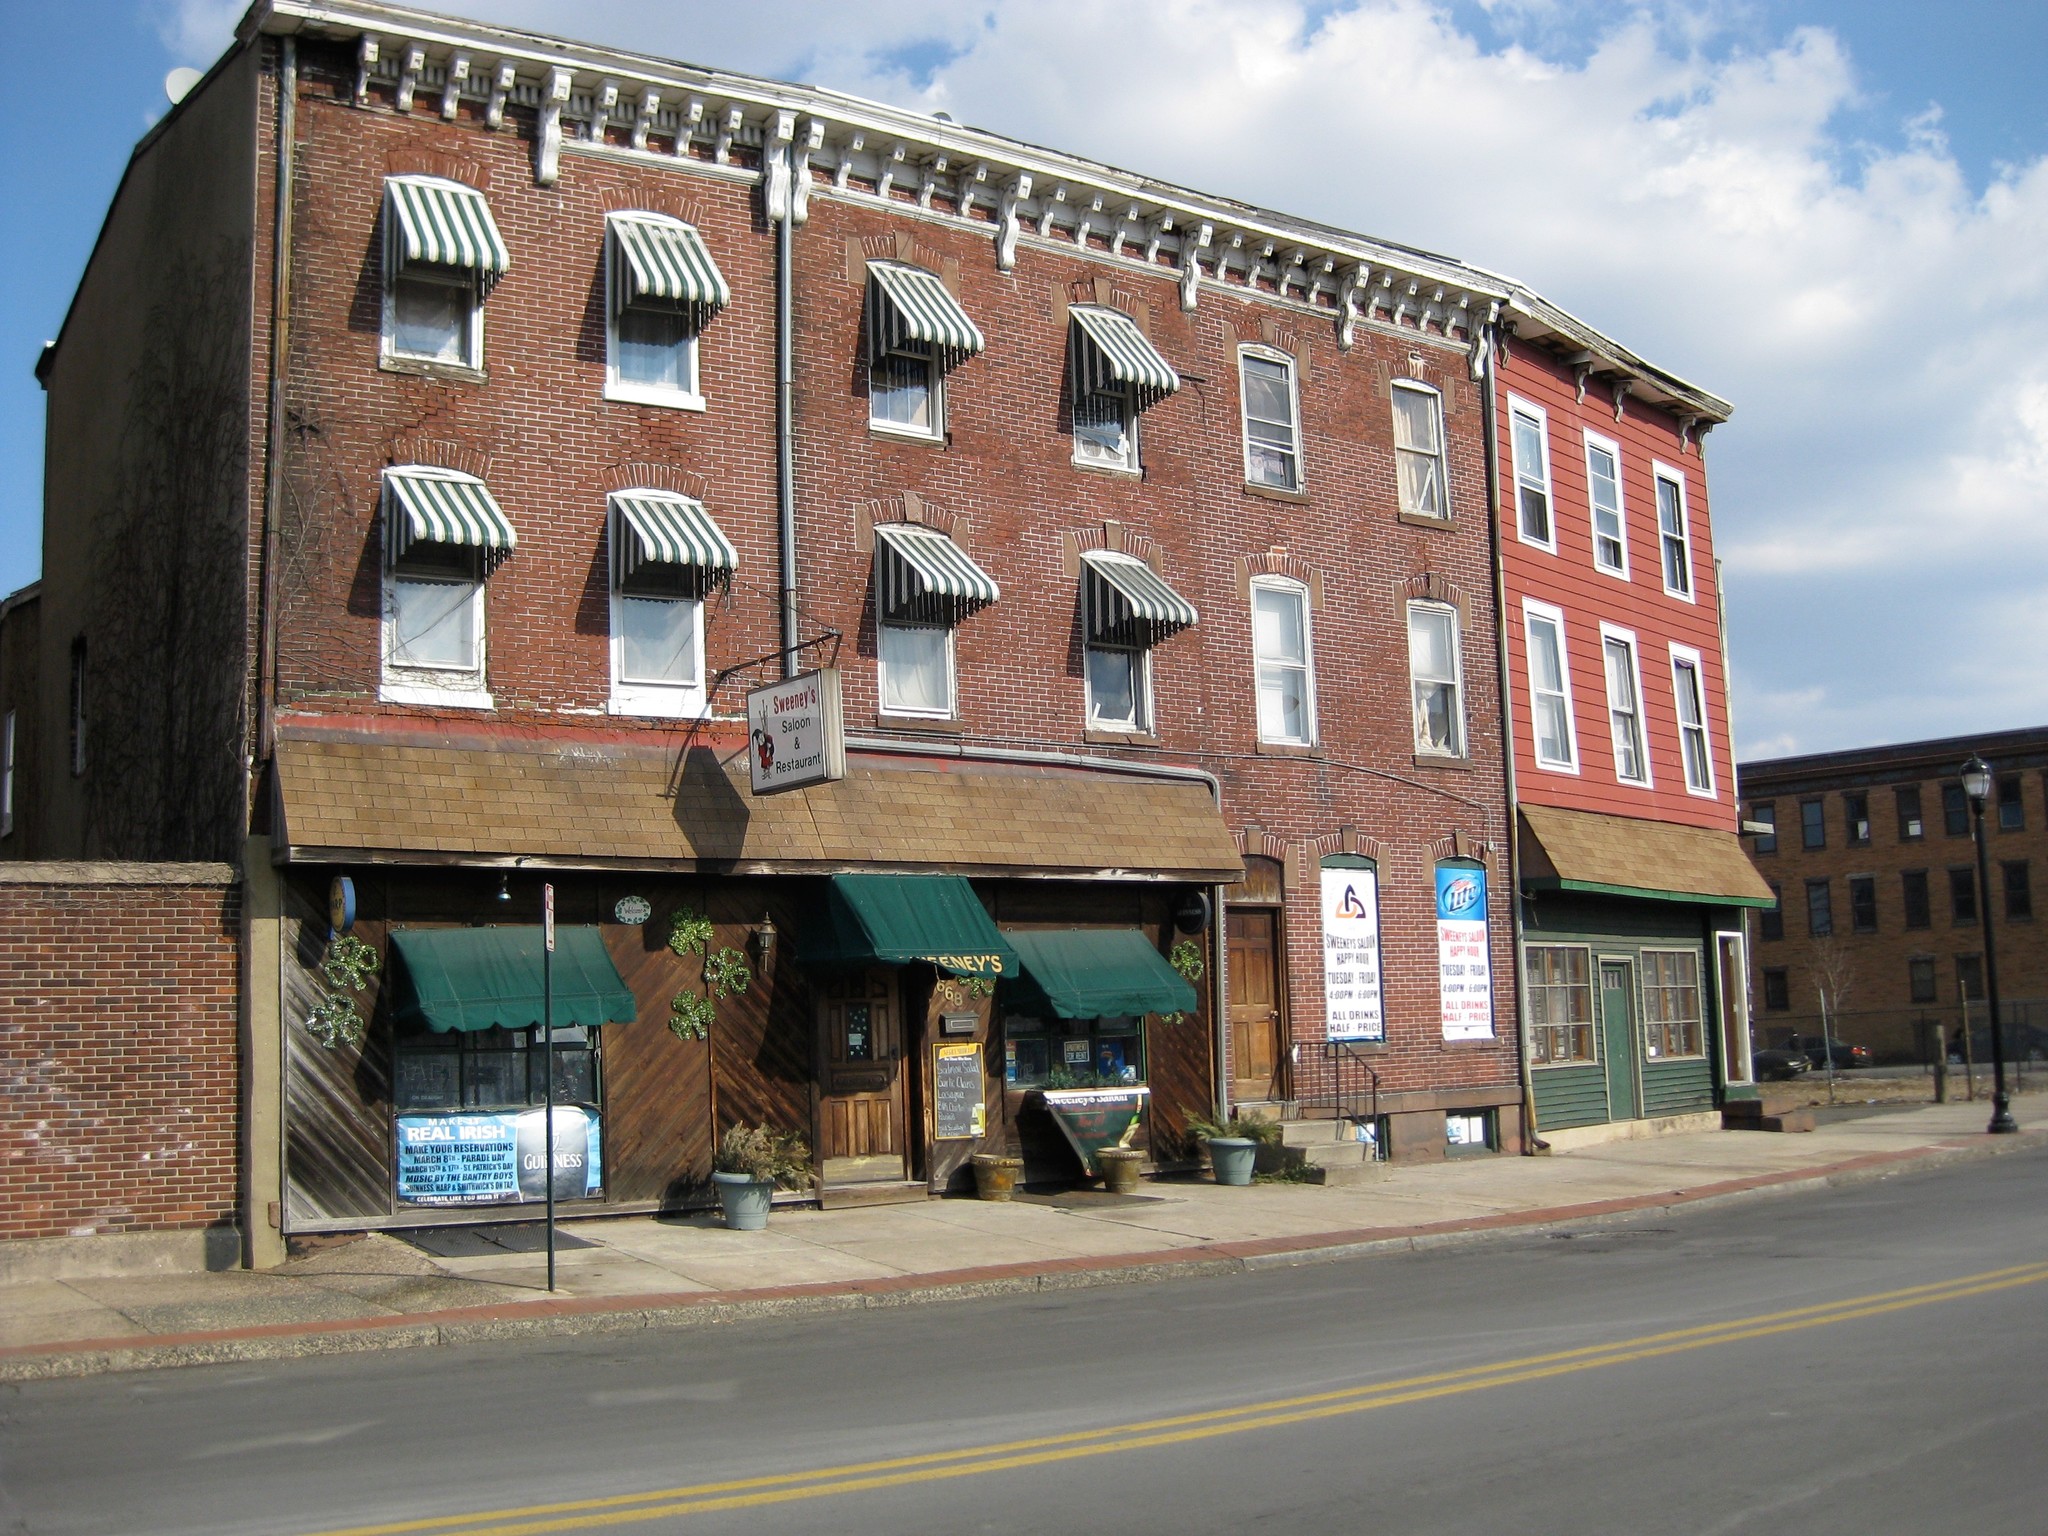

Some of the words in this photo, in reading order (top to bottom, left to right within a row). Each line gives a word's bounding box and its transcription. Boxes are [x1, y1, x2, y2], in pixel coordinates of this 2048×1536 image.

[773, 686, 816, 714] Sweeney's
[782, 717, 811, 733] Saloon
[794, 737, 801, 750] &
[776, 752, 821, 774] Restaurant
[1450, 885, 1477, 912] Lite
[1358, 934, 1375, 949] SALOON
[1468, 929, 1485, 942] SALOON
[1450, 946, 1466, 957] HAPPY
[1467, 946, 1480, 957] HOUR
[1336, 953, 1354, 965] HAPPY
[1356, 953, 1369, 965] HOUR
[1442, 964, 1465, 976] TUESDAY
[1470, 964, 1486, 976] FRIDAY
[1328, 972, 1354, 984] TUESDAY
[1359, 972, 1376, 984] FRIDAY
[937, 980, 963, 1007] 668
[1329, 990, 1353, 999] 4:00PM
[1358, 990, 1378, 999] 6:00PM
[1442, 984, 1464, 993] 4:00PM
[1469, 984, 1488, 993] 6:00PM
[1446, 1001, 1459, 1010] ALL
[1461, 1001, 1489, 1010] DRINKS
[1332, 1011, 1346, 1020] ALL
[1349, 1010, 1379, 1020] DRINKS
[1443, 1013, 1462, 1021] HALF
[1469, 1012, 1490, 1021] PRICE
[1330, 1023, 1350, 1033] HALF
[1358, 1022, 1381, 1032] PRICE
[428, 1118, 462, 1126] MAKE
[407, 1127, 456, 1141] REAL
[460, 1125, 506, 1140] IRISH
[405, 1145, 429, 1155] MAKE
[430, 1144, 453, 1153] YOUR
[453, 1143, 514, 1153] RESERVATIONS
[413, 1155, 442, 1164] MARCH
[461, 1154, 490, 1163] PARADE
[491, 1153, 506, 1162] DAY
[524, 1153, 583, 1170] GUINESS
[405, 1165, 428, 1174] MARCH
[472, 1163, 502, 1171] PATRICK'S
[502, 1162, 514, 1170] DAY
[405, 1175, 433, 1184] MUSIC
[434, 1174, 445, 1183] BY
[447, 1174, 461, 1182] THE
[462, 1173, 492, 1182] BANTRY
[493, 1172, 514, 1181] BOYS
[416, 1195, 448, 1203] CELEBRATE
